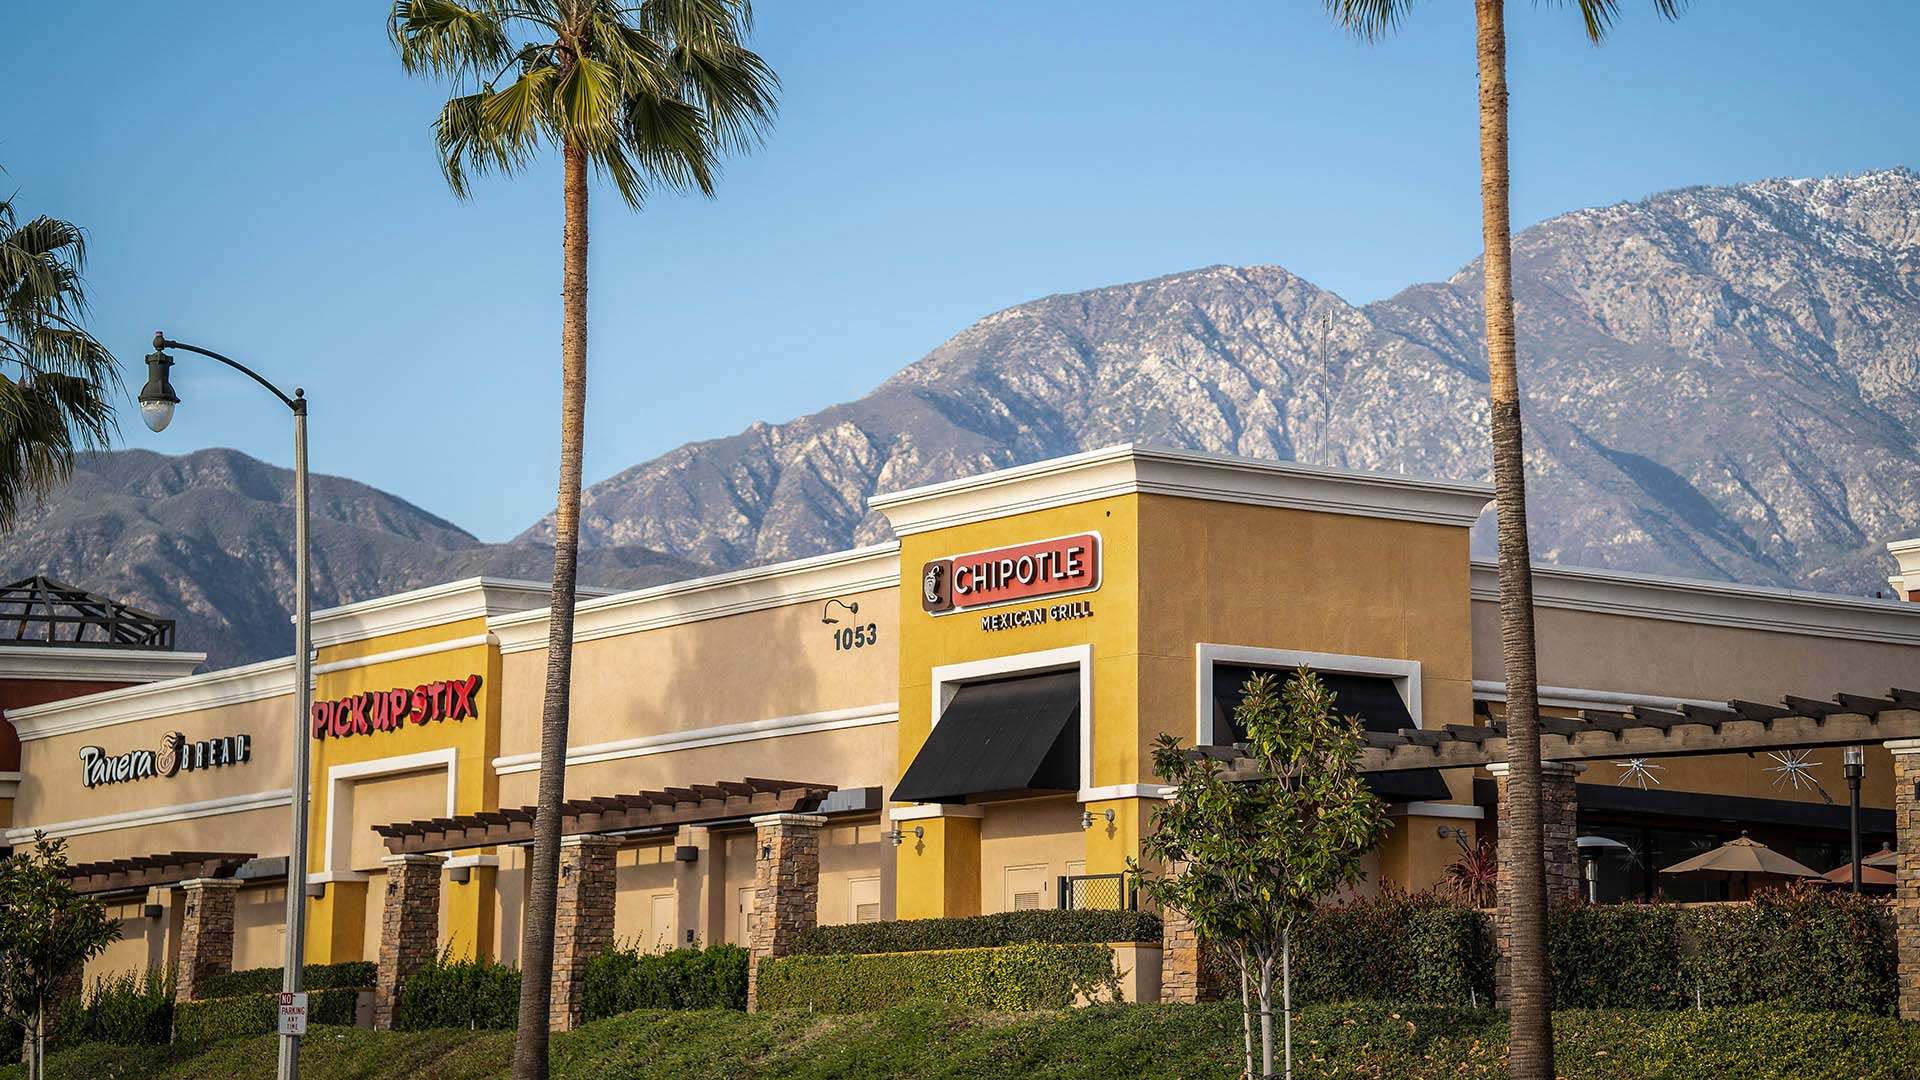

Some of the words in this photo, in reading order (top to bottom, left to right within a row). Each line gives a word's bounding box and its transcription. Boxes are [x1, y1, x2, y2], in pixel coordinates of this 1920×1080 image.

[954, 547, 1083, 595] CHIPOTLE
[980, 610, 1043, 631] MEXICAN
[1049, 602, 1092, 619] GRILL
[834, 623, 877, 651] 1053
[80, 745, 153, 788] Panera
[182, 734, 250, 770] BREAD
[281, 993, 292, 1005] NO
[281, 1007, 305, 1015] PARKING
